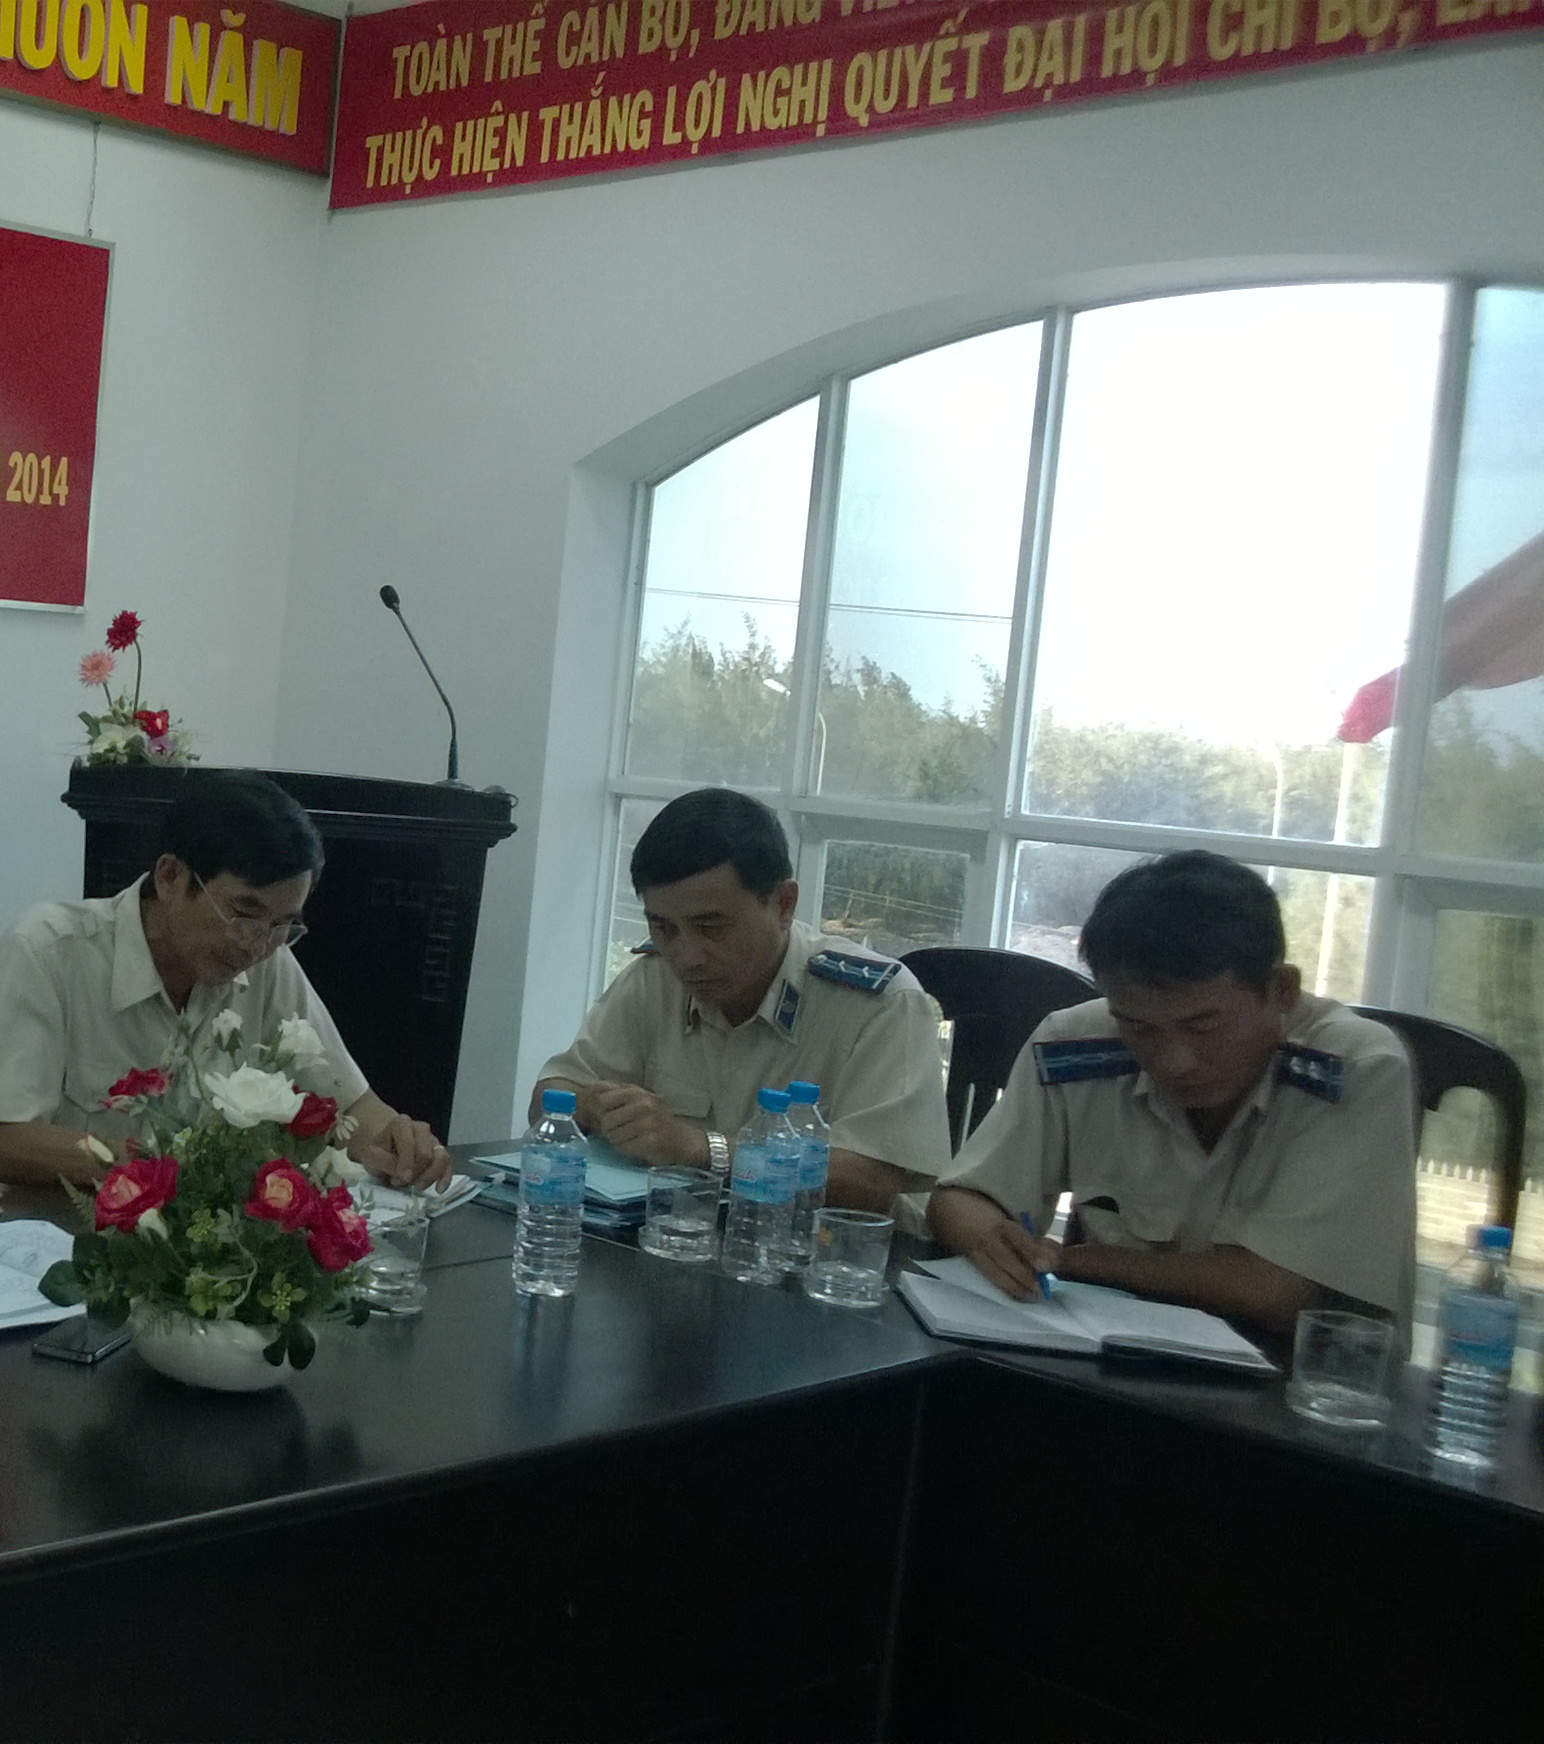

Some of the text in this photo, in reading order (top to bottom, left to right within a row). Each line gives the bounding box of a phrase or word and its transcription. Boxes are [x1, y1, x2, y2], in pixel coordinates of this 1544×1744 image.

[164, 9, 304, 136] NĂM
[365, 116, 444, 195] THỰC
[451, 100, 529, 183] HIỆN
[538, 71, 654, 164] THẮNG
[662, 69, 727, 154] LỢI
[736, 58, 833, 137] NGHỊ
[844, 7, 990, 127] QUYẾT
[1002, 12, 1088, 102] ĐẠI
[393, 23, 473, 99] TOÀN
[6, 450, 69, 506] 2014
